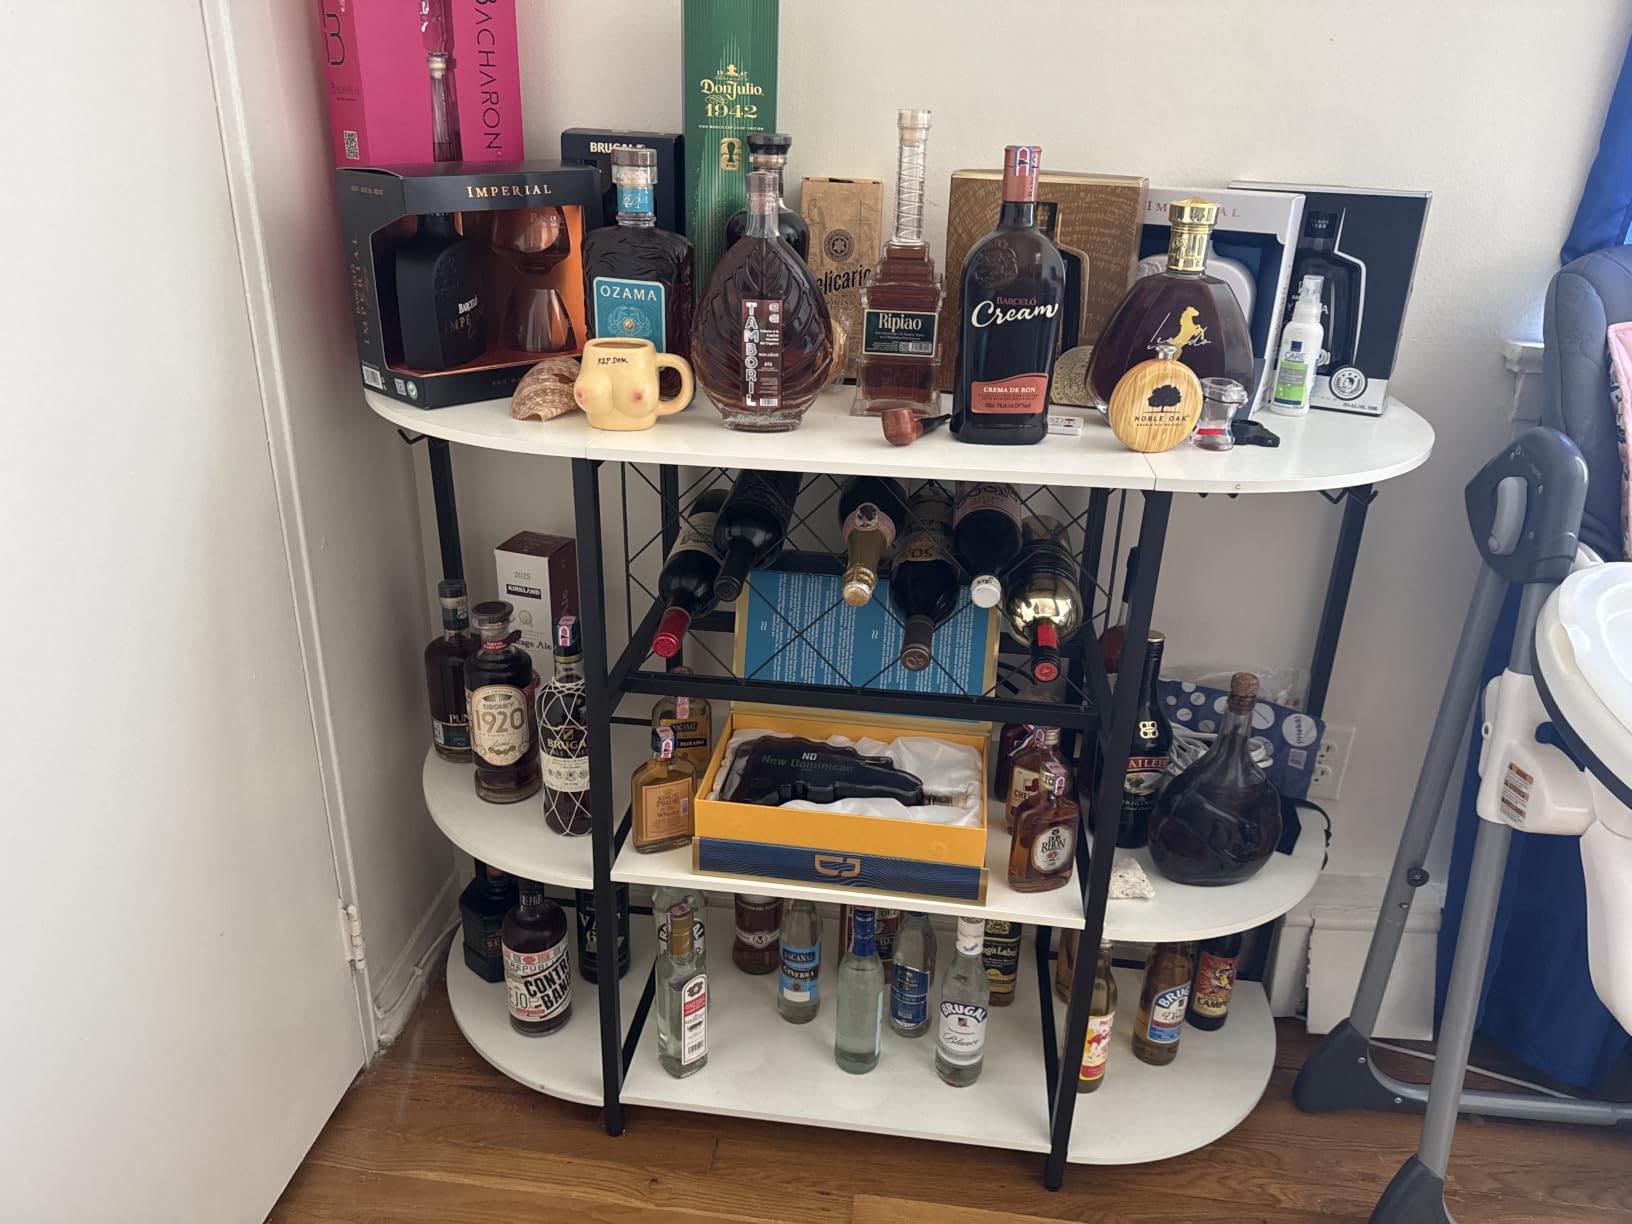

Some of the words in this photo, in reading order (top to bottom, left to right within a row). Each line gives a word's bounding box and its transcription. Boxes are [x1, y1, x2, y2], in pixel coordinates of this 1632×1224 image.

[704, 103, 758, 119] 1942
[466, 184, 553, 199] IMPERIAL
[1145, 200, 1241, 218] IMAL
[815, 264, 871, 296] elicari
[600, 285, 657, 302] OZAMA
[996, 296, 1037, 306] BARCELÓ
[971, 299, 1059, 328] Cream
[878, 312, 922, 333] Ripiao
[743, 301, 760, 407] TAMBORIL
[1284, 351, 1305, 361] CARE
[1168, 414, 1188, 422] OAK
[513, 571, 531, 580] 2025
[507, 585, 541, 597] KIRKLAND
[514, 638, 535, 649] tage
[537, 641, 551, 650] Ale
[449, 714, 471, 724] PUN
[474, 707, 525, 734] 1920
[547, 738, 588, 750] BRUGA
[761, 754, 787, 767] New
[790, 758, 853, 772] Dominican
[802, 752, 818, 761] ND
[784, 952, 813, 961] BACANAL
[783, 965, 815, 978] GINEBRA
[1157, 986, 1191, 1008] BRUG
[941, 1002, 986, 1022] BRUGAL
